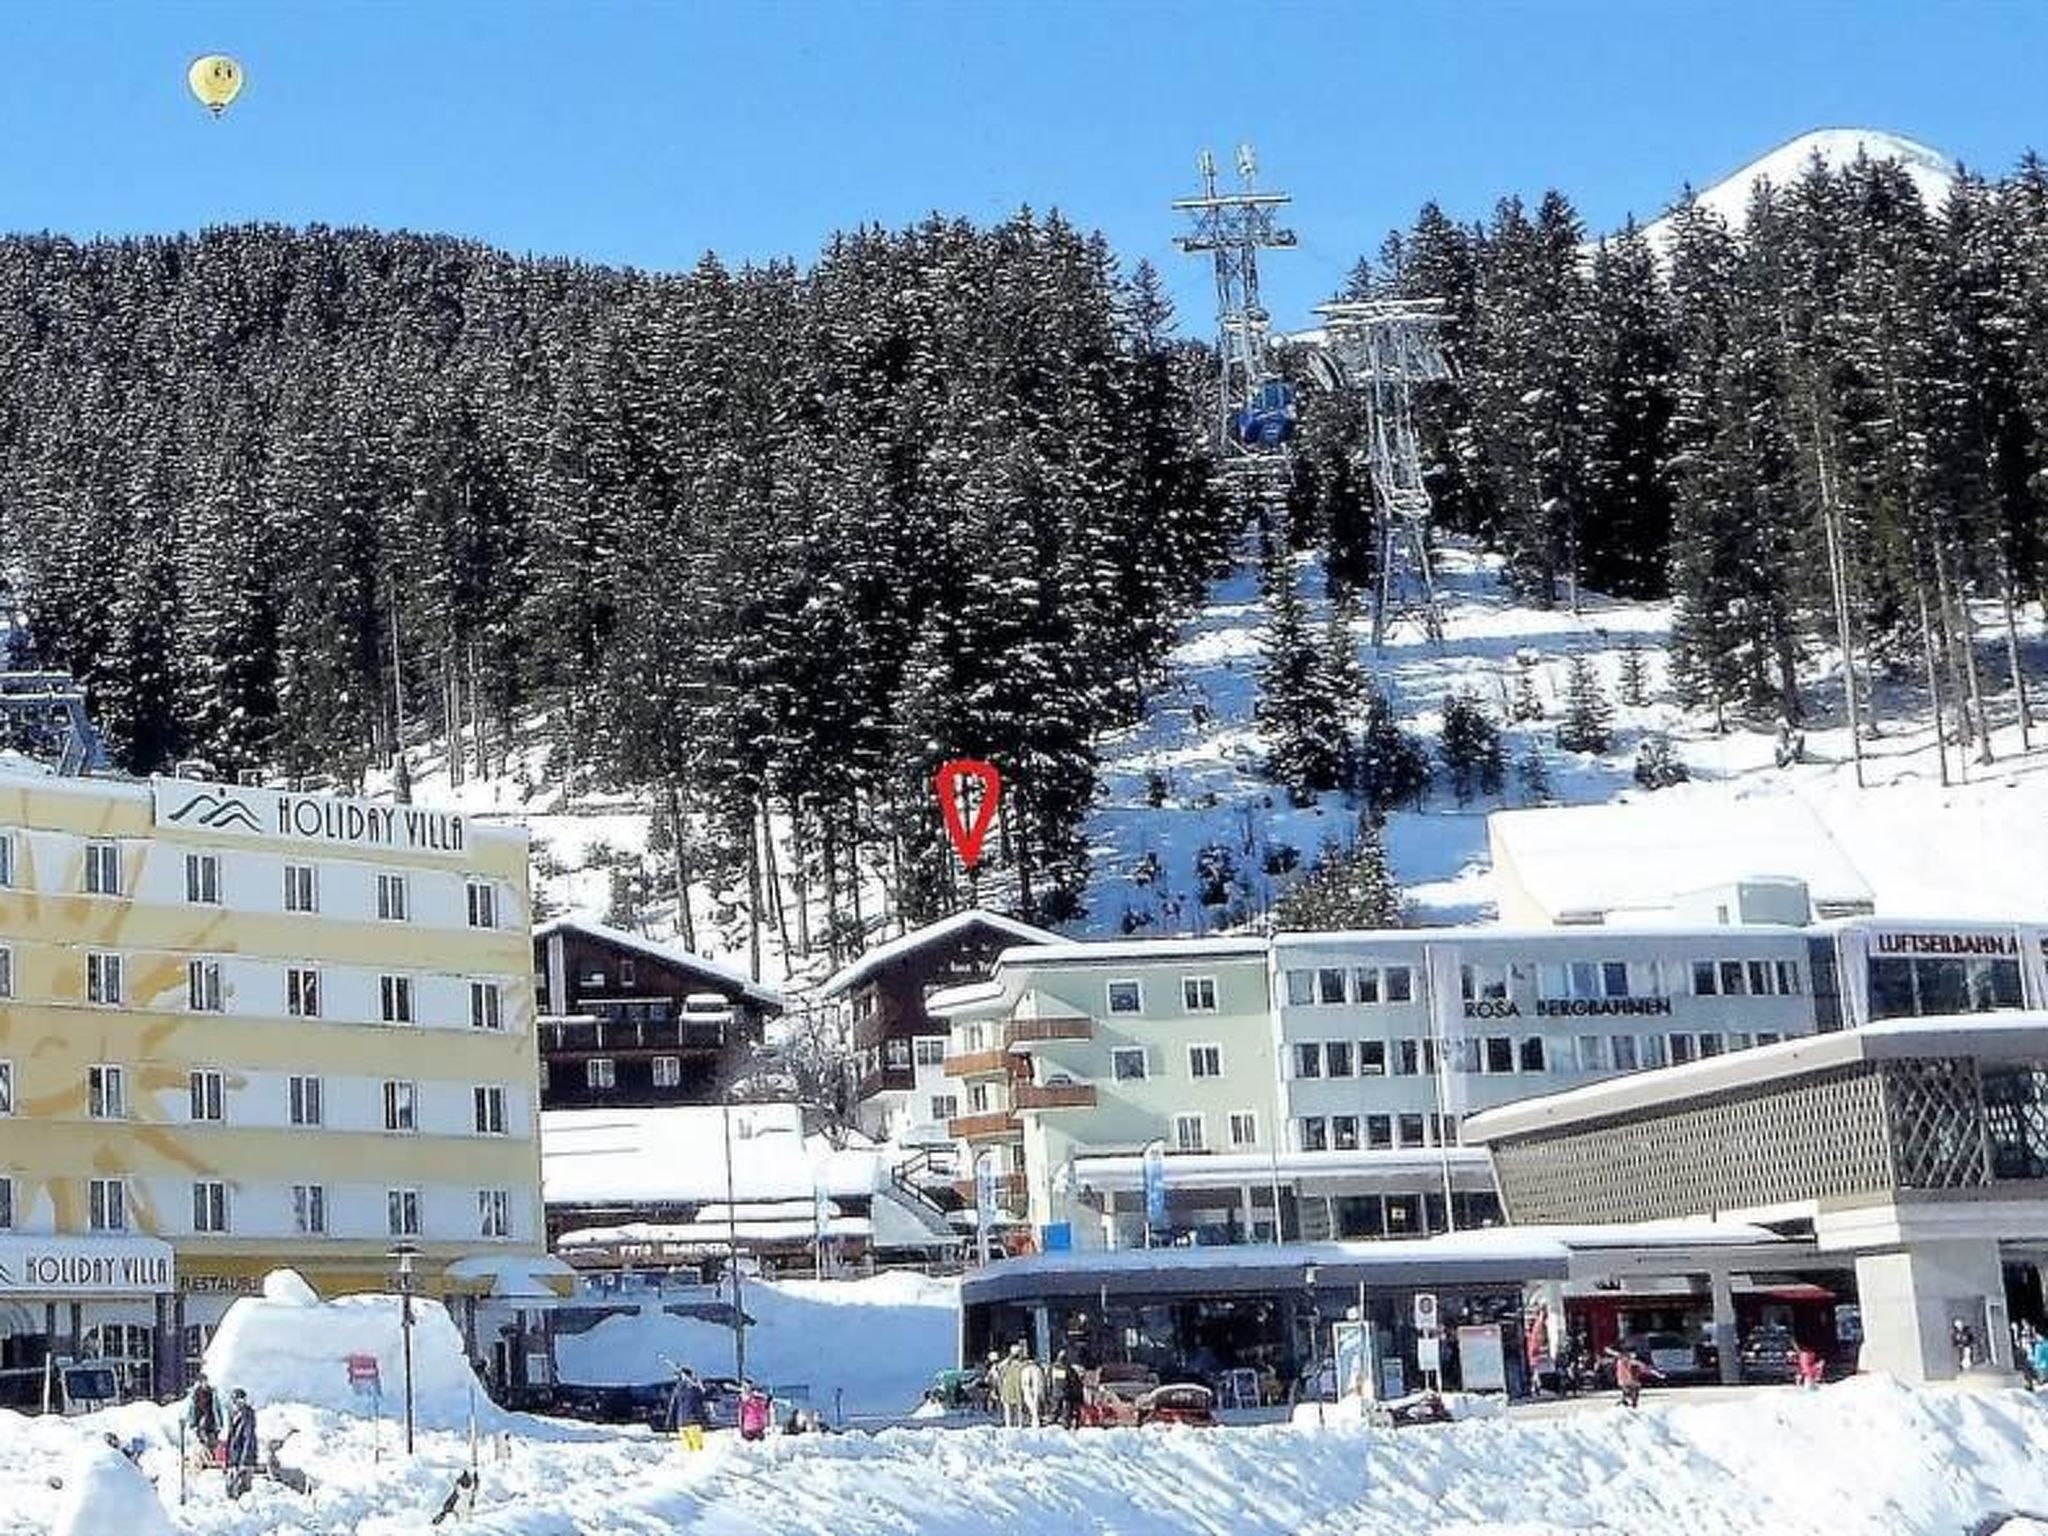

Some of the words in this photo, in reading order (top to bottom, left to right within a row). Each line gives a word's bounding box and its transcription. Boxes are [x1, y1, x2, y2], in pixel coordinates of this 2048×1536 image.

[277, 796, 395, 844] HOLIDAY
[404, 811, 464, 851] VILLA
[1878, 933, 2004, 955] LUFTSEILBAHN
[1536, 998, 1673, 1017] BERGBAHNEN
[25, 1257, 115, 1286] HOLIDAY
[121, 1257, 168, 1286] VILLA
